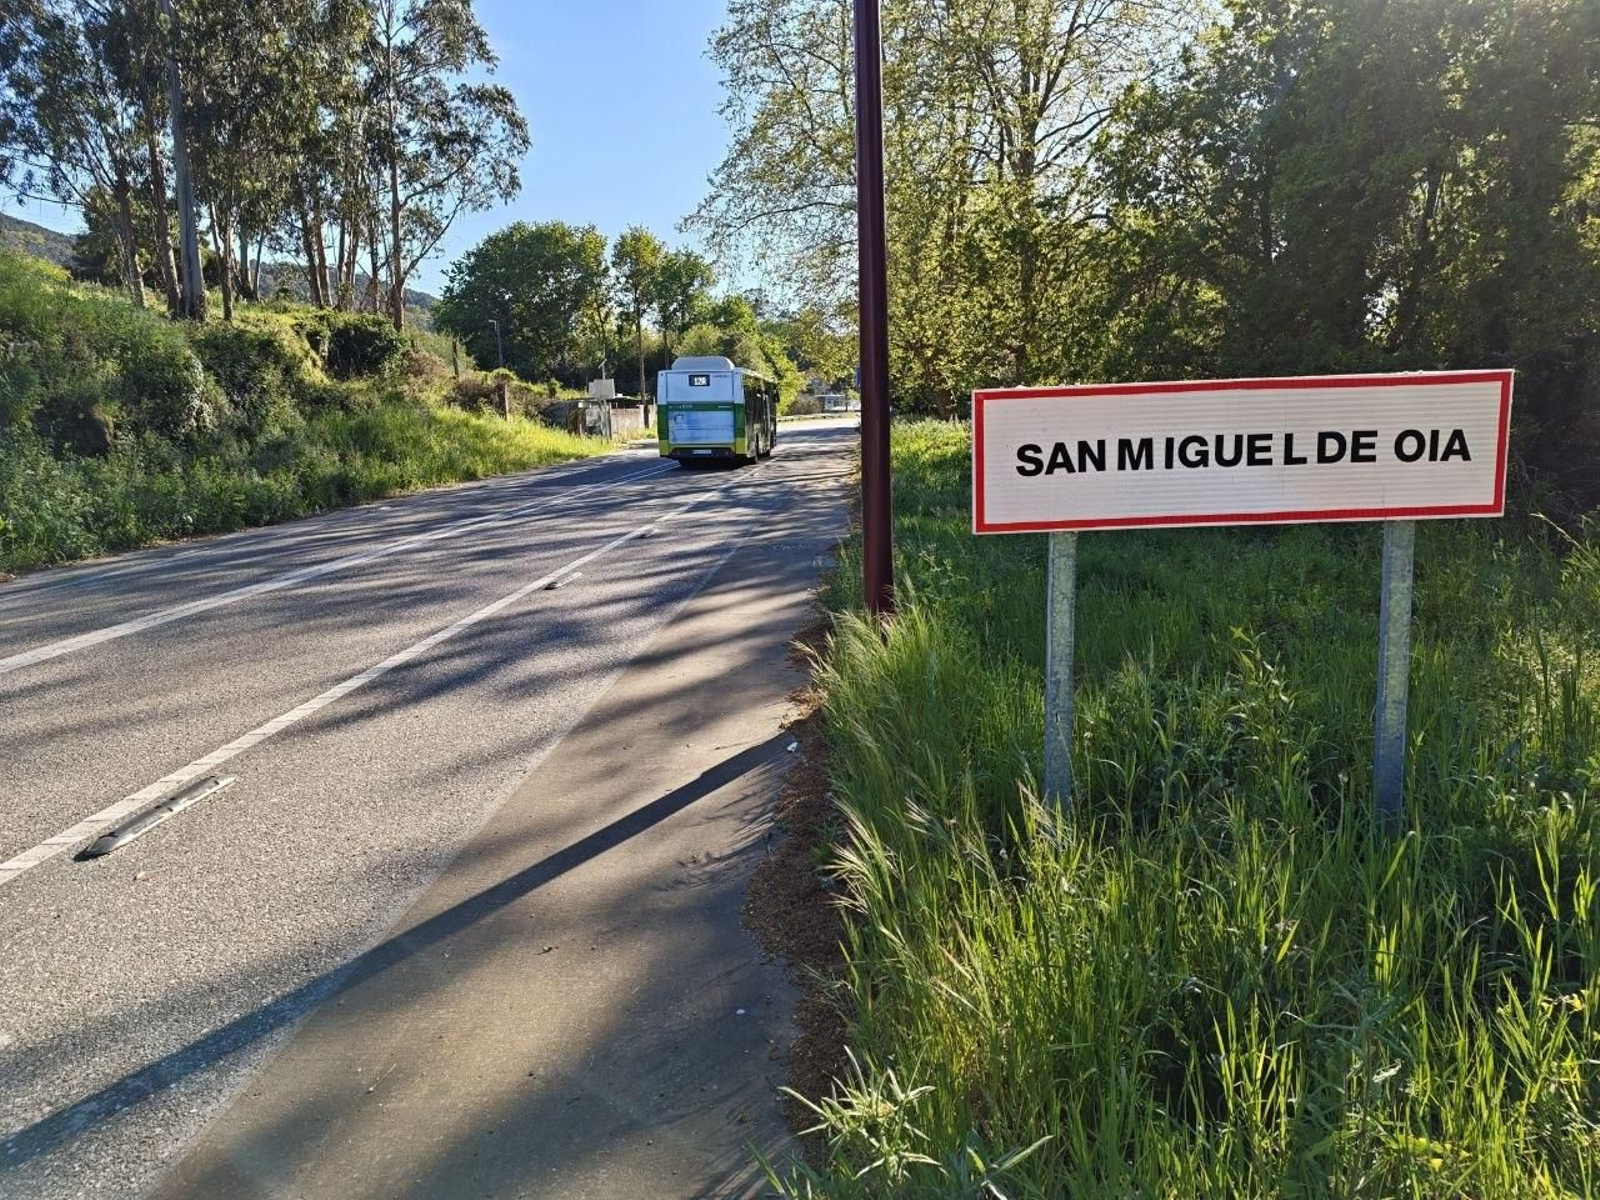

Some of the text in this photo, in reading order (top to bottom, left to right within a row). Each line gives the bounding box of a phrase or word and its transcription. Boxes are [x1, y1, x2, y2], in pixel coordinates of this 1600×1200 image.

[1015, 428, 1472, 477] SAN MIGUEL DE OIA
